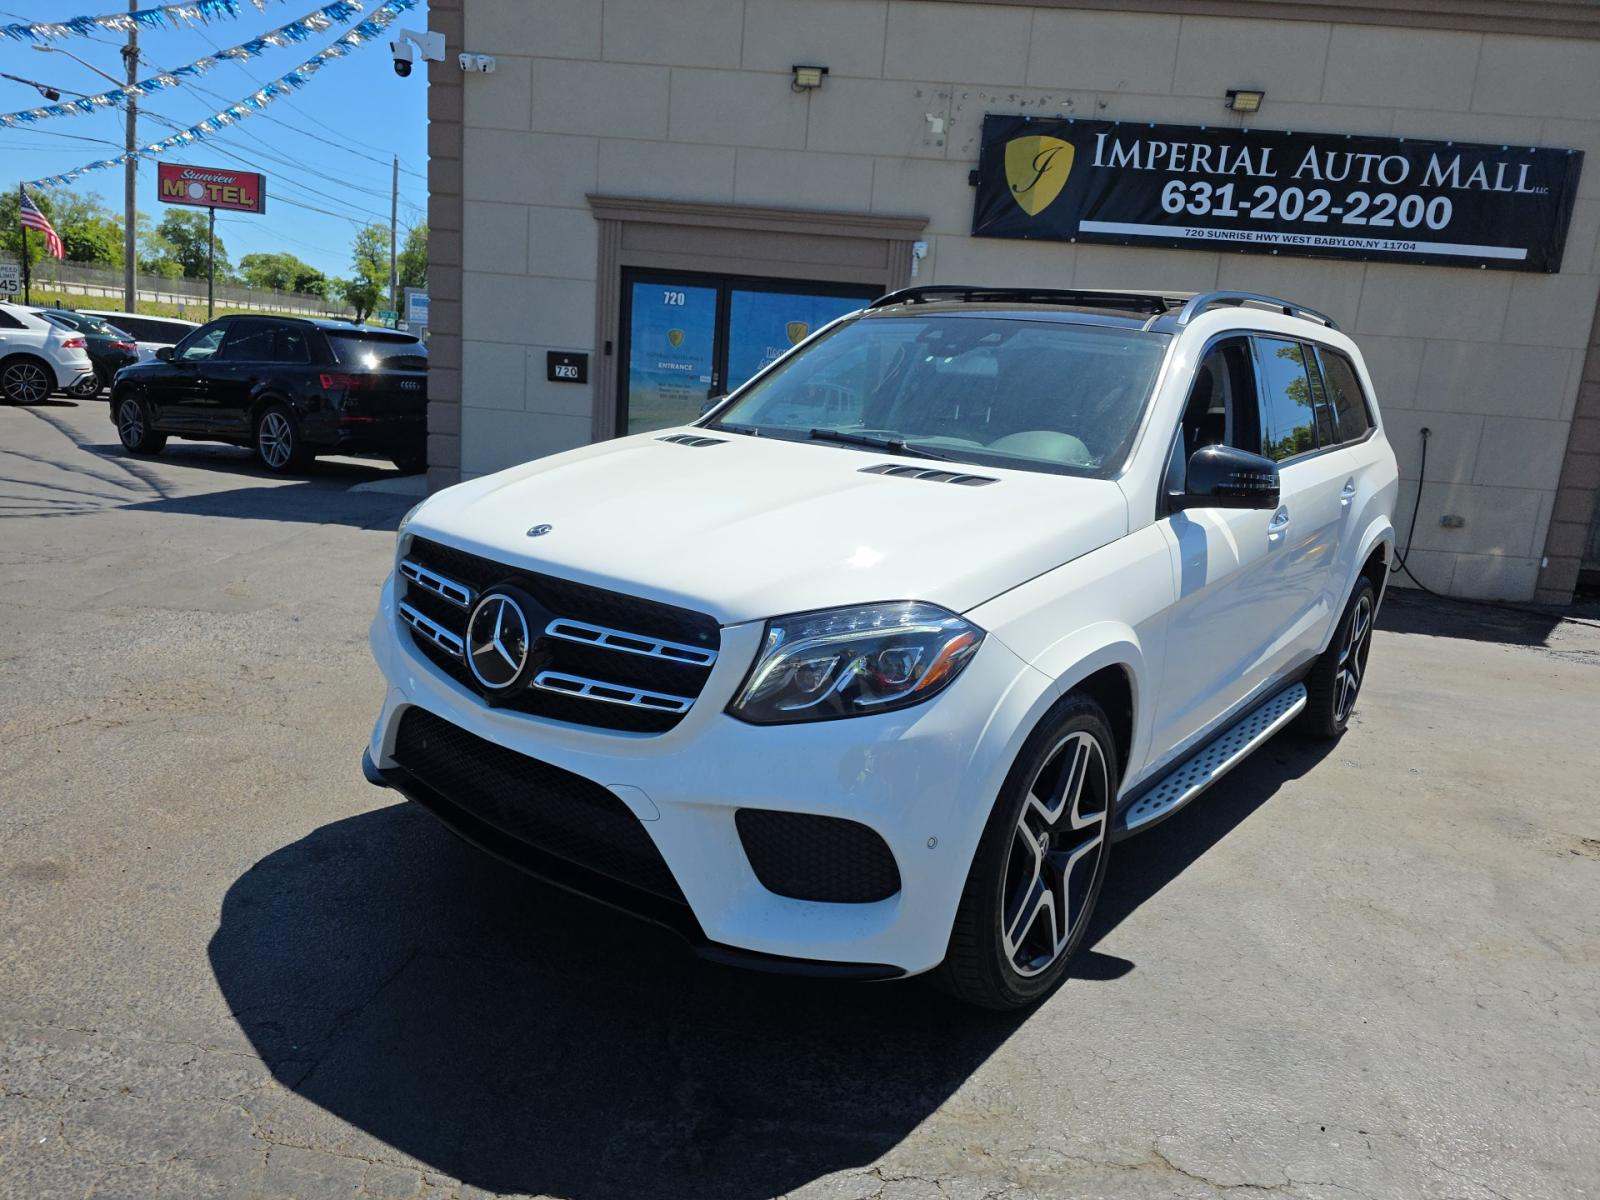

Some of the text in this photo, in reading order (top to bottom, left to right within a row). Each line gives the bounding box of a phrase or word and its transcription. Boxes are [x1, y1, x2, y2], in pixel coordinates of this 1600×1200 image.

[1091, 132, 1277, 177] IMPERIAL
[1289, 145, 1410, 185] AUTO
[1418, 152, 1535, 193] MALL
[180, 168, 237, 184] Sunview
[163, 179, 255, 208] MOTEL
[1161, 179, 1453, 230] 631-202-2200
[1184, 228, 1204, 238] 720
[1206, 230, 1253, 241] SUNRISE
[1255, 233, 1280, 242] HWY
[1282, 235, 1312, 244] WEST
[1382, 241, 1416, 251] 11704
[0, 279, 18, 291] 45
[664, 291, 685, 306] 720
[557, 366, 577, 377] 720
[658, 362, 693, 371] ENTRANCE
